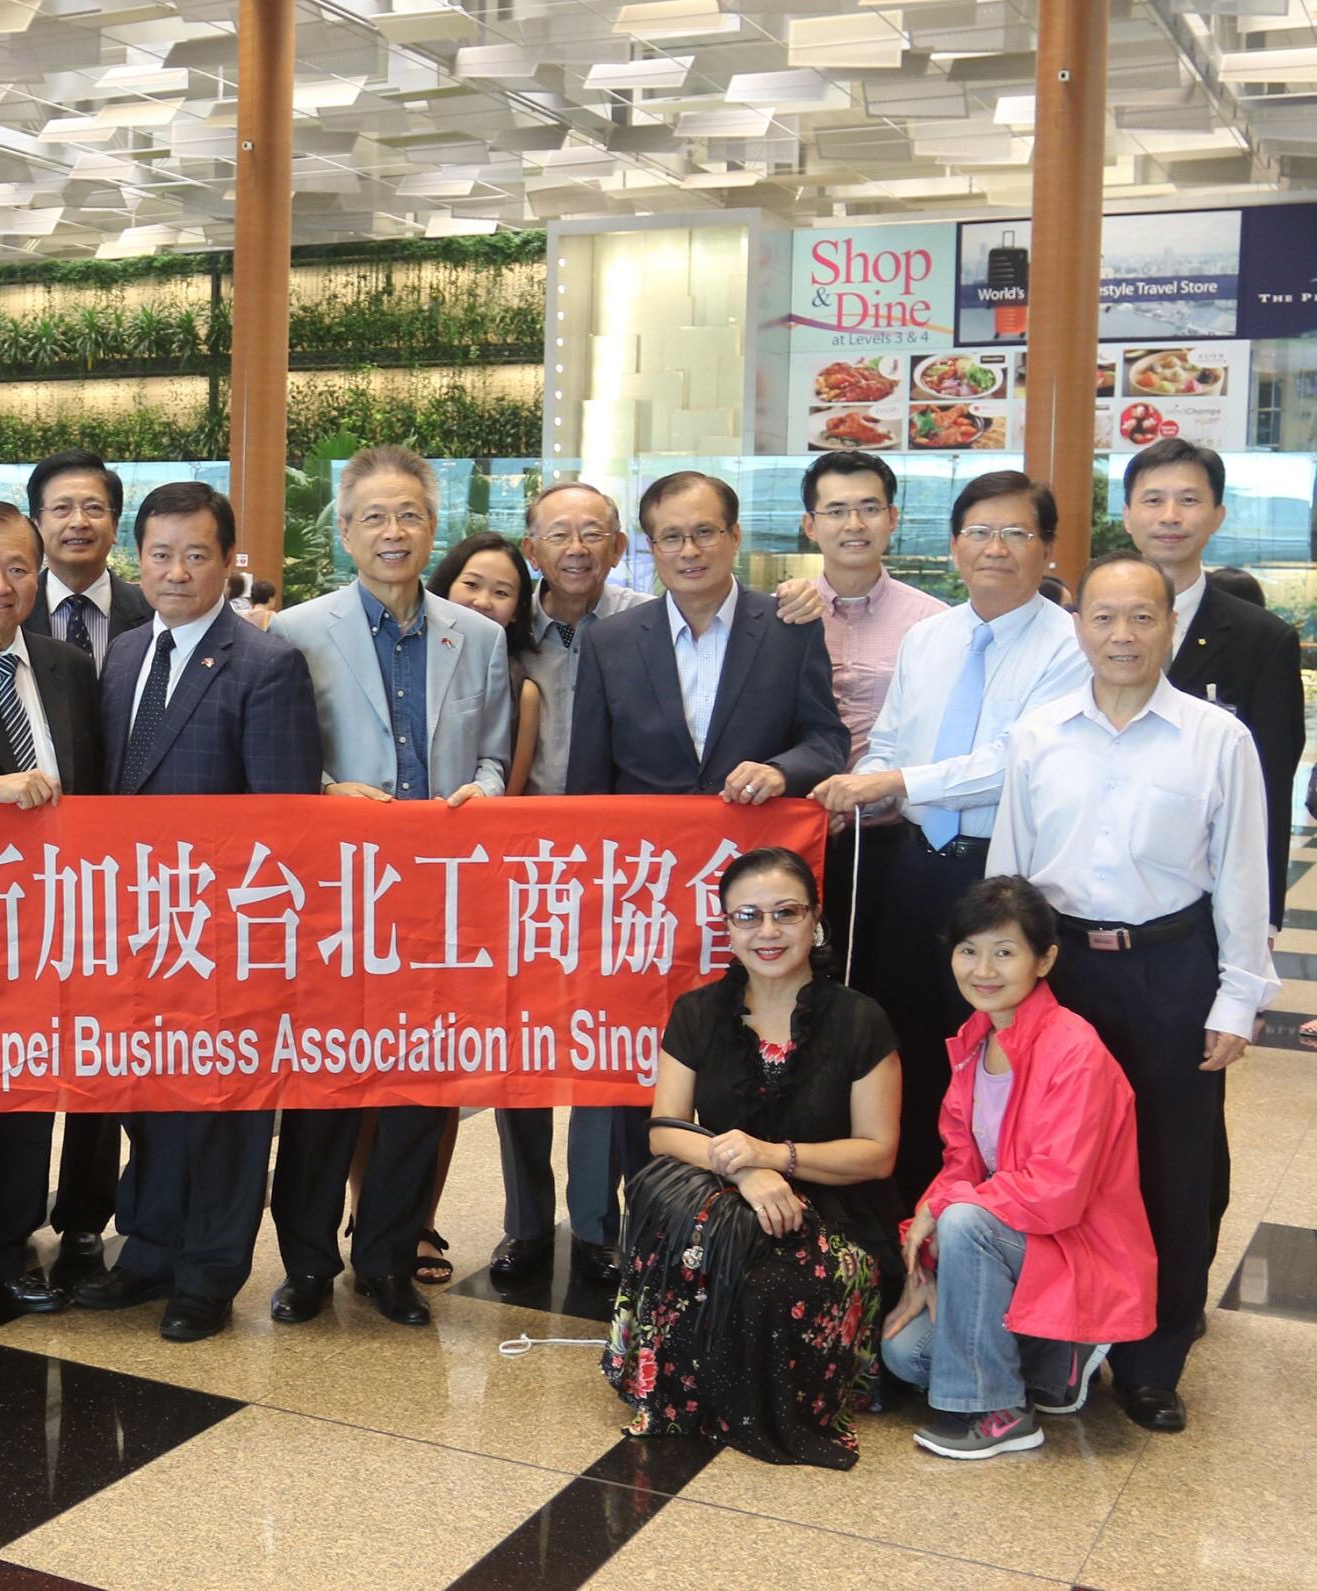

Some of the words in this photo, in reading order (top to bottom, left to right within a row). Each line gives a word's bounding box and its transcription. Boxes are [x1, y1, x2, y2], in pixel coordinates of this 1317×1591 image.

[811, 238, 932, 295] Shop
[812, 287, 831, 307] &
[834, 290, 931, 330] Dine
[978, 287, 1025, 300] World's
[1099, 283, 1135, 298] estyle
[1136, 281, 1178, 295] Travel
[1180, 280, 1218, 294] Store
[833, 335, 844, 345] at
[849, 332, 891, 345] Levels
[895, 332, 903, 344] 3
[907, 332, 918, 343] &
[921, 331, 930, 343] 4
[75, 1015, 260, 1077] Business
[271, 1012, 508, 1074] Association
[521, 1010, 556, 1072] in
[569, 1009, 663, 1088] Sing
